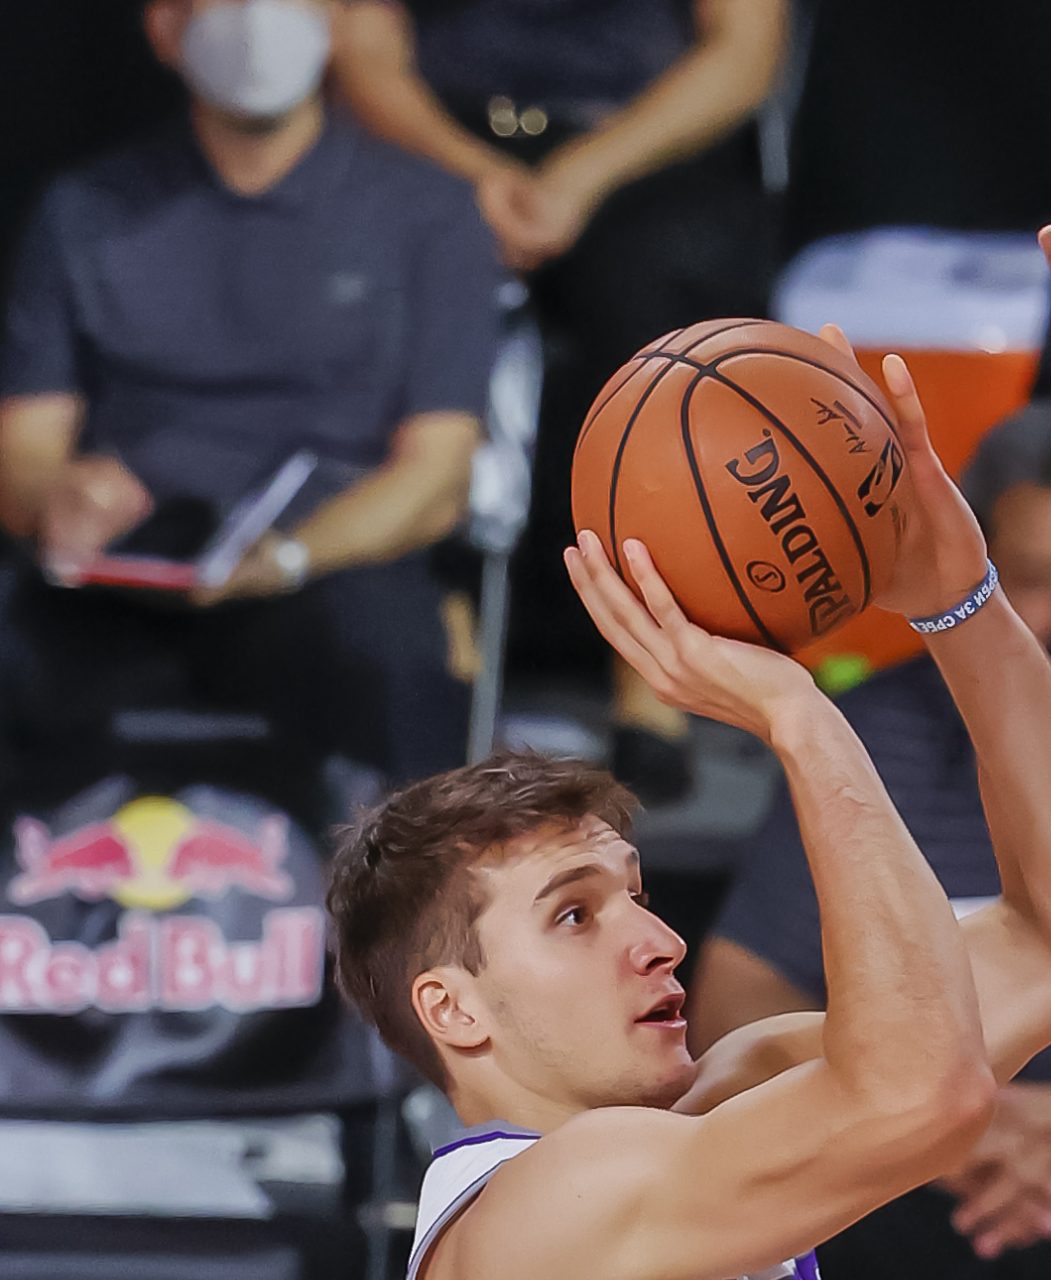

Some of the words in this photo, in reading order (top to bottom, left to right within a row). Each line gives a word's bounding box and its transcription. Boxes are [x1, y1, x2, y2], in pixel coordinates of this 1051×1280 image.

[954, 601, 975, 620] ЗА
[0, 911, 152, 1013] Red
[154, 905, 325, 1013] Bull
